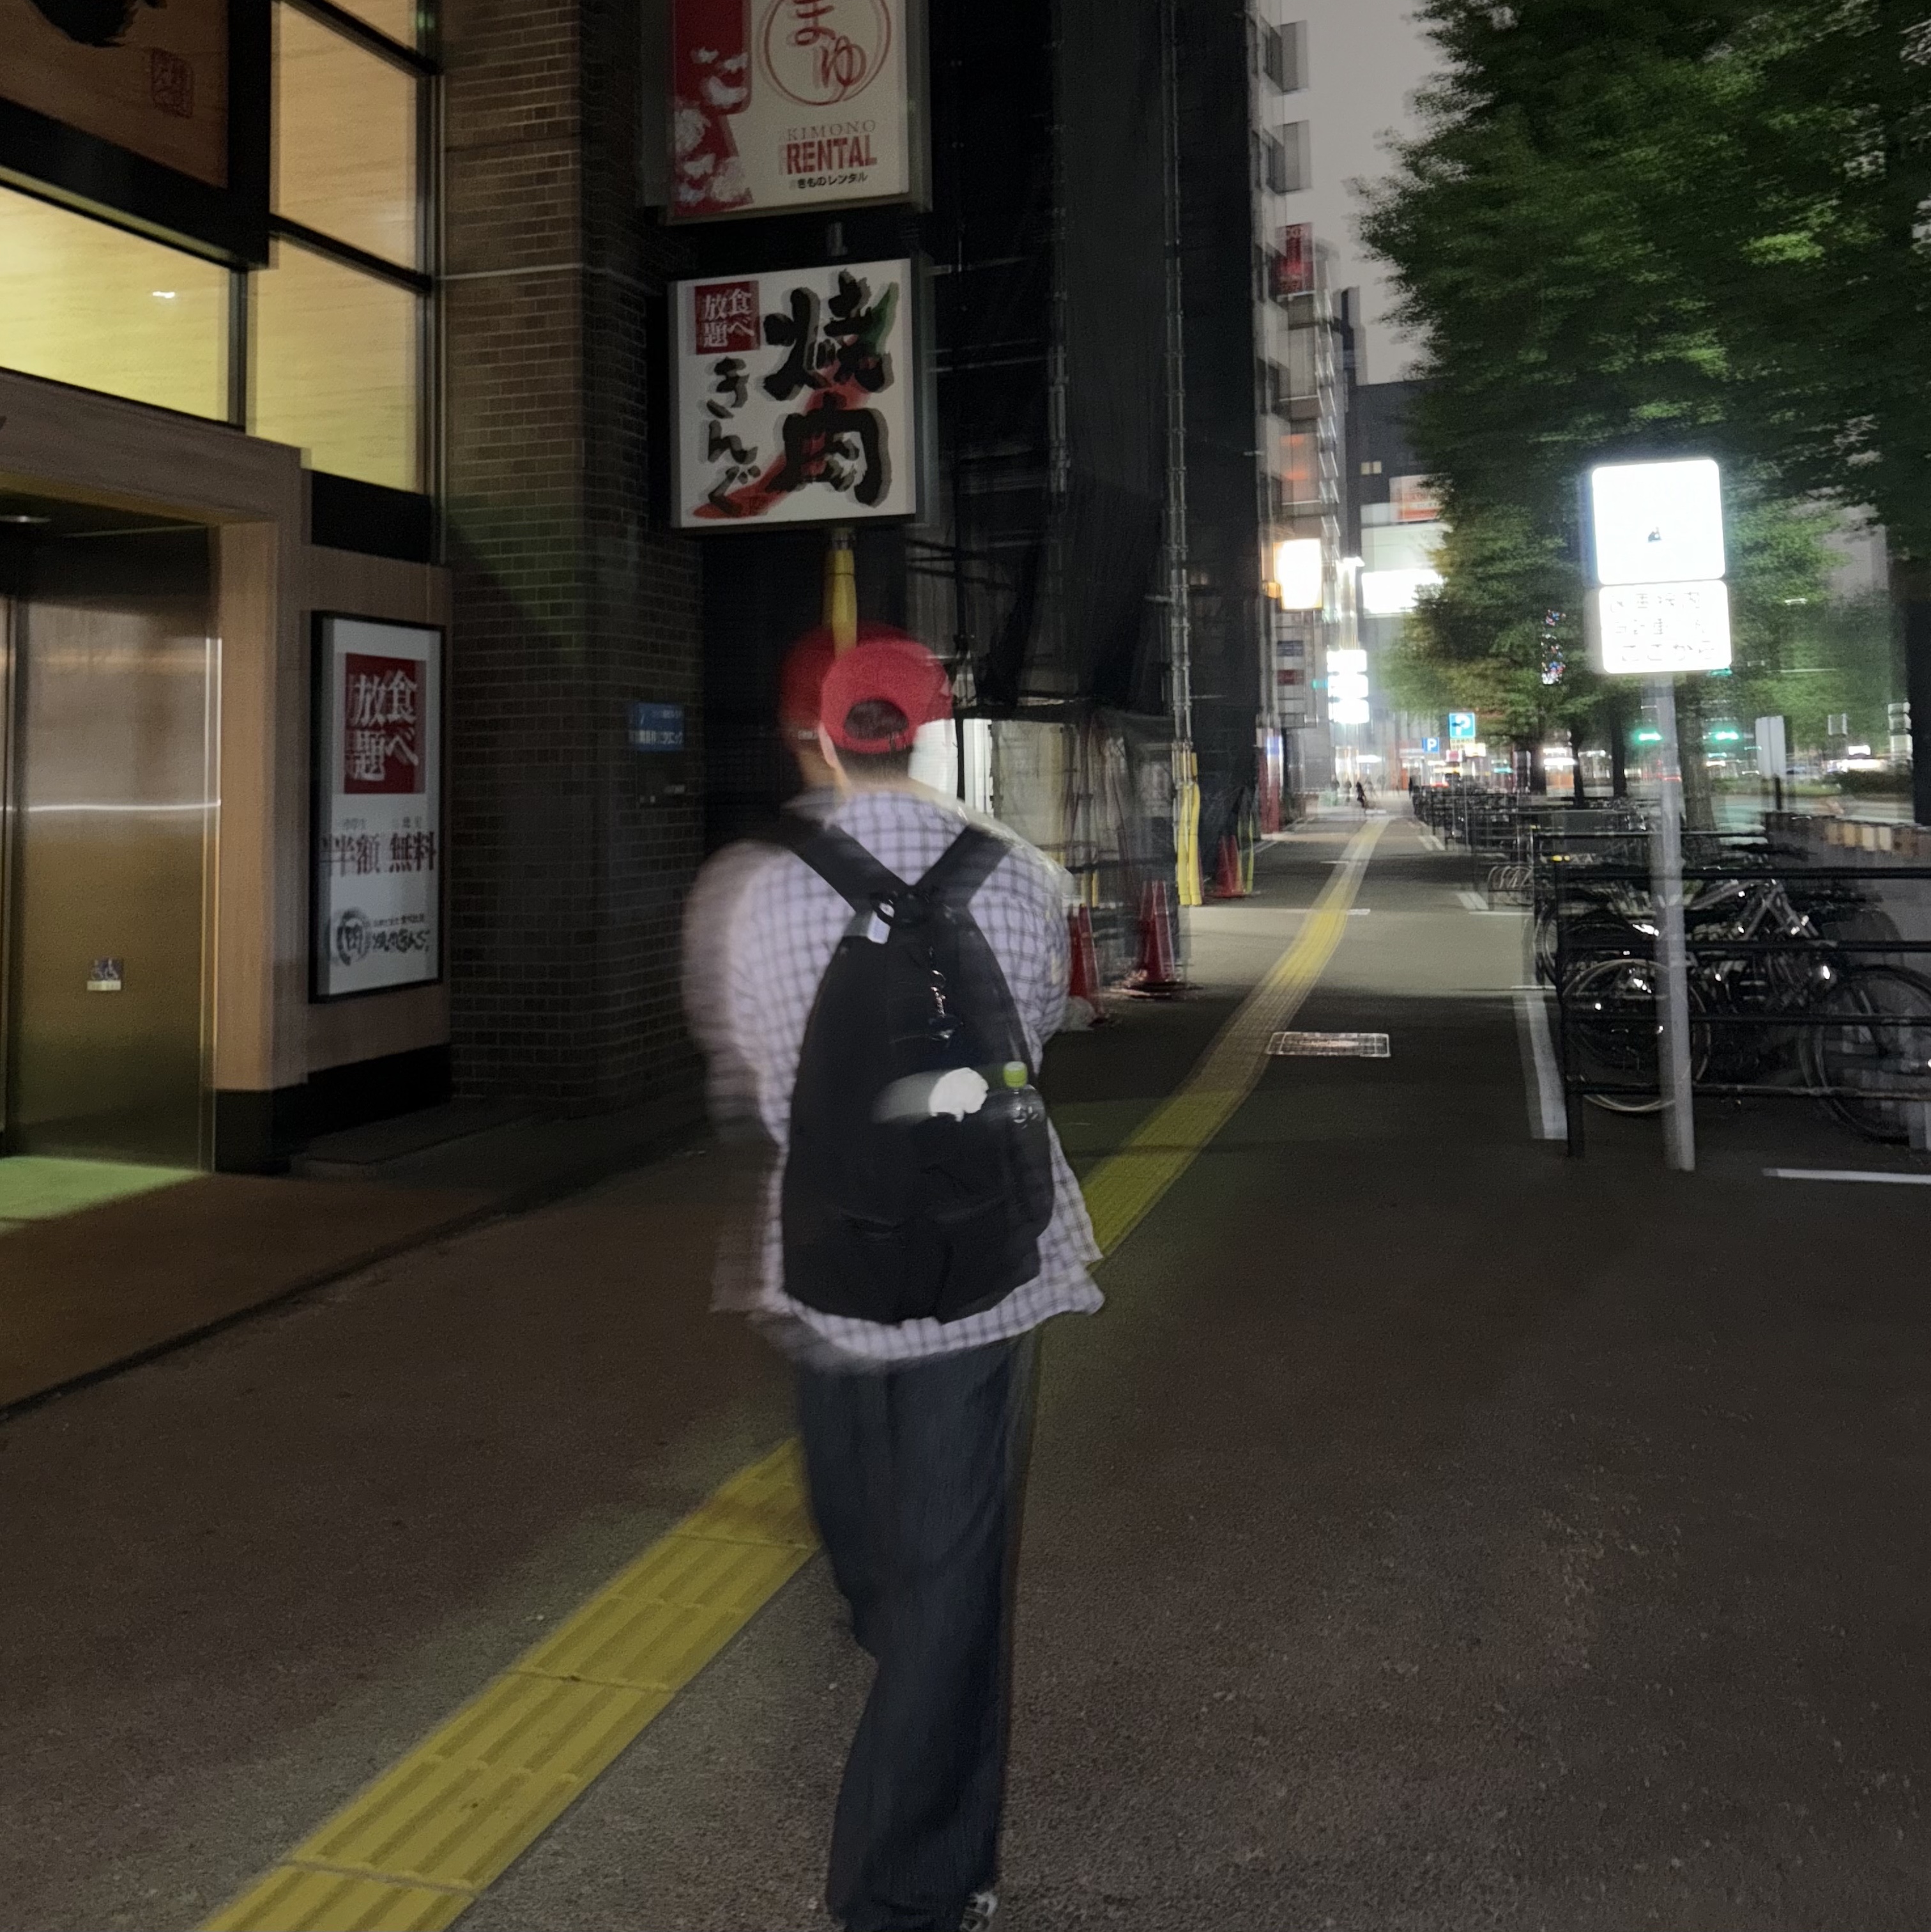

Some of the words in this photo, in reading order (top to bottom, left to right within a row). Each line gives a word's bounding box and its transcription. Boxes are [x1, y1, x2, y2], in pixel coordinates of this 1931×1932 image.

[788, 119, 876, 141] KIMONO
[786, 135, 877, 174] RENTAL
[797, 172, 867, 189] きものレンタル
[763, 268, 893, 508] 焼肉
[707, 356, 760, 517] きんぐ
[1426, 738, 1437, 751] P
[331, 835, 382, 877] 半額
[390, 831, 437, 873] 無料
